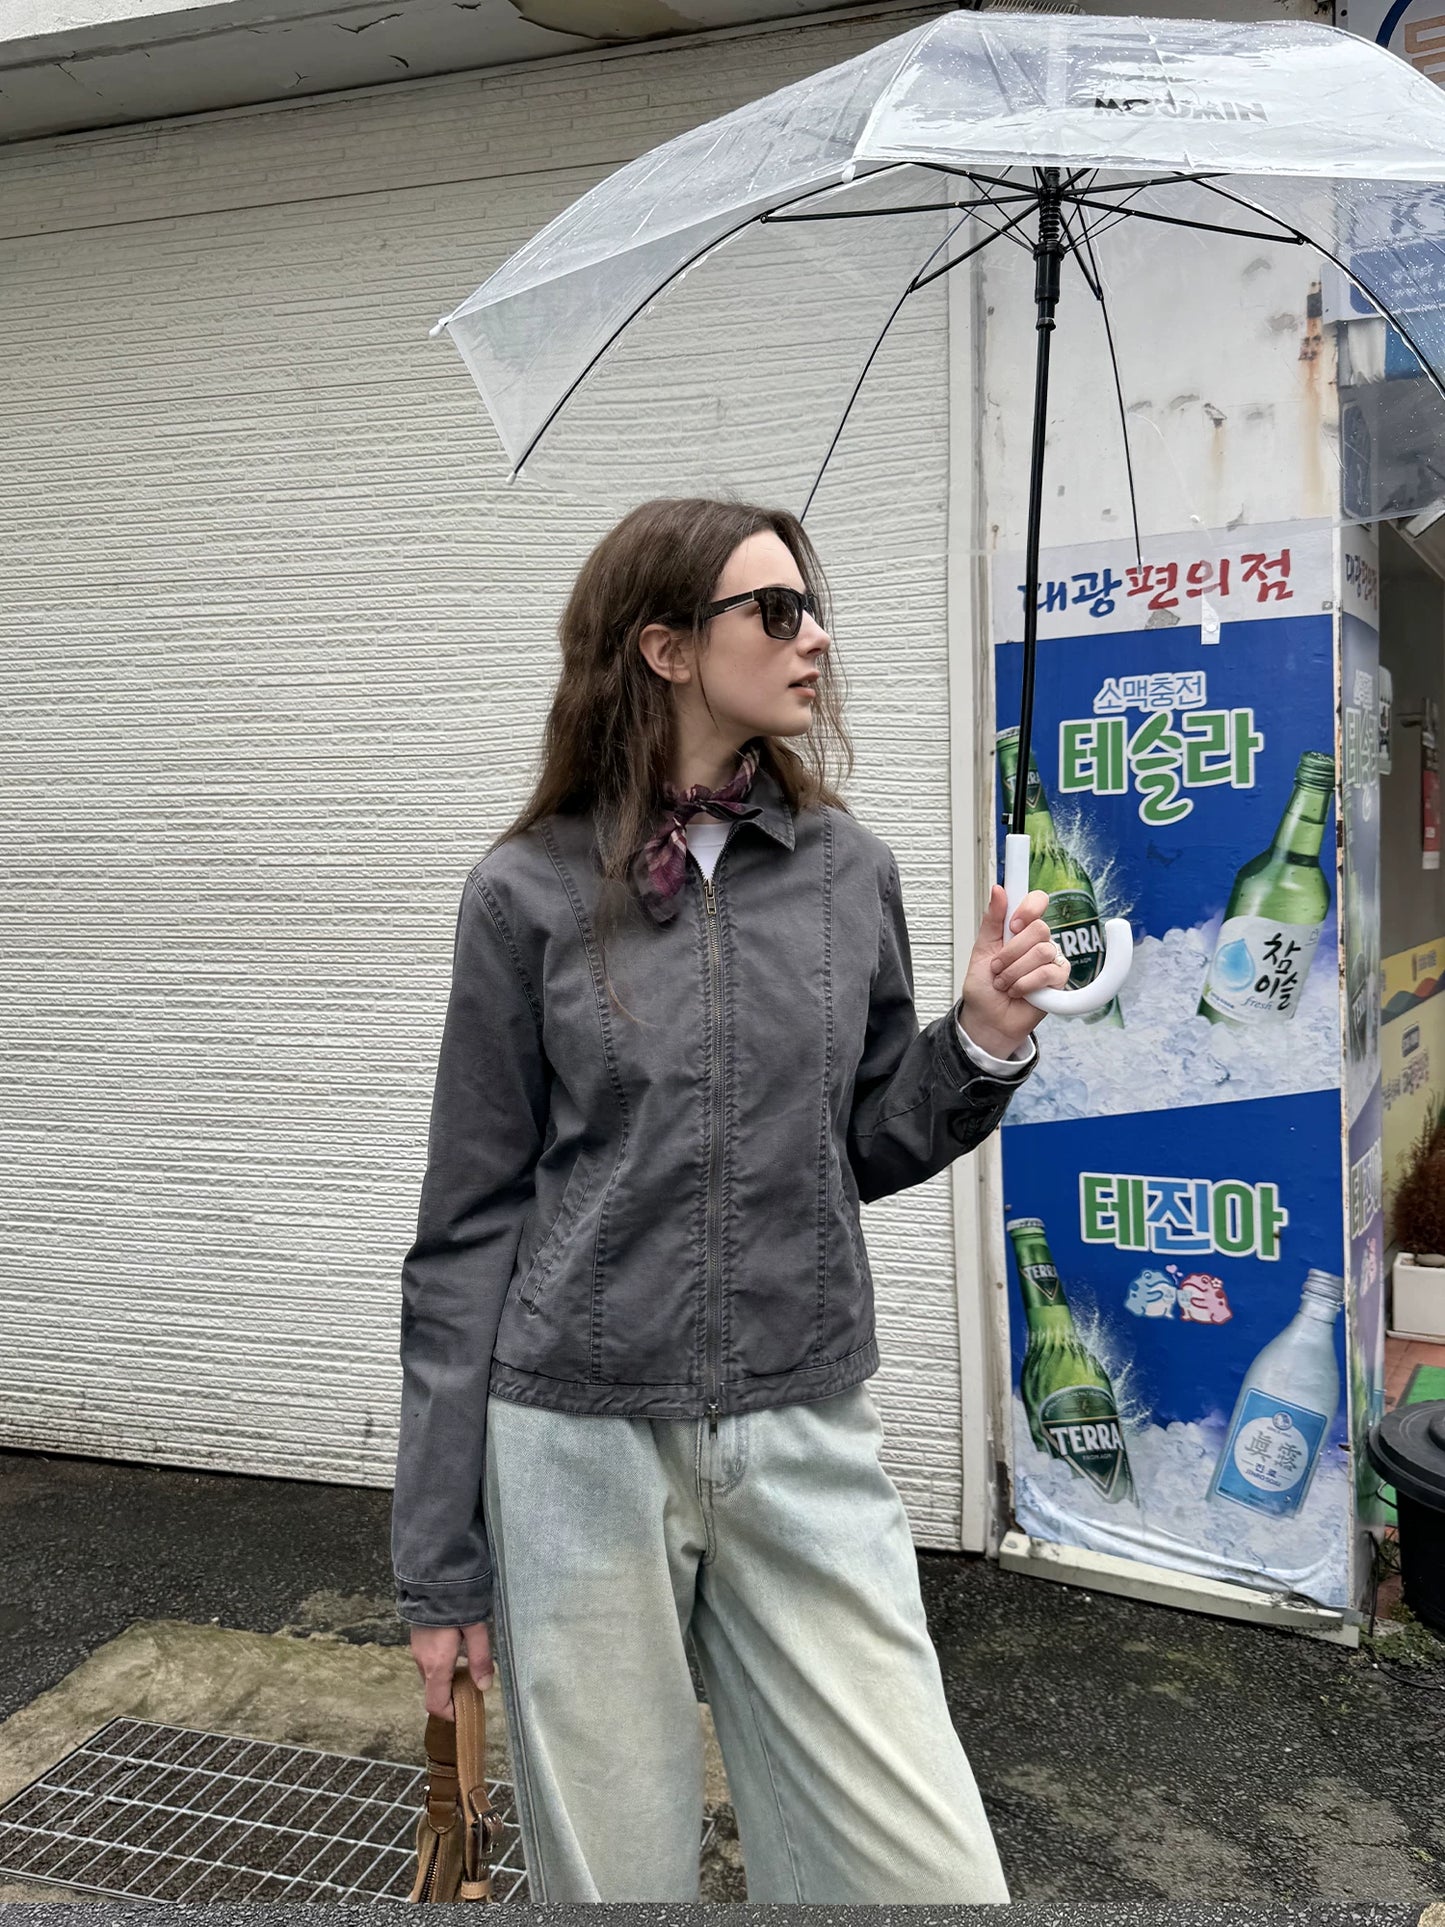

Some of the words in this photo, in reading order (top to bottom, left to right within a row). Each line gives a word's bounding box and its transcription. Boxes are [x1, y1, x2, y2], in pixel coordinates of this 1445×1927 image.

[1094, 672, 1206, 713] 소맥충전
[1060, 709, 1263, 825] 테슬라
[1262, 932, 1301, 974] 참
[1241, 996, 1272, 1010] fresh
[1254, 971, 1298, 1011] 이슬
[1079, 1172, 1288, 1261] 테진아
[1023, 1264, 1058, 1280] TERRA
[1049, 1422, 1124, 1456] TERRA
